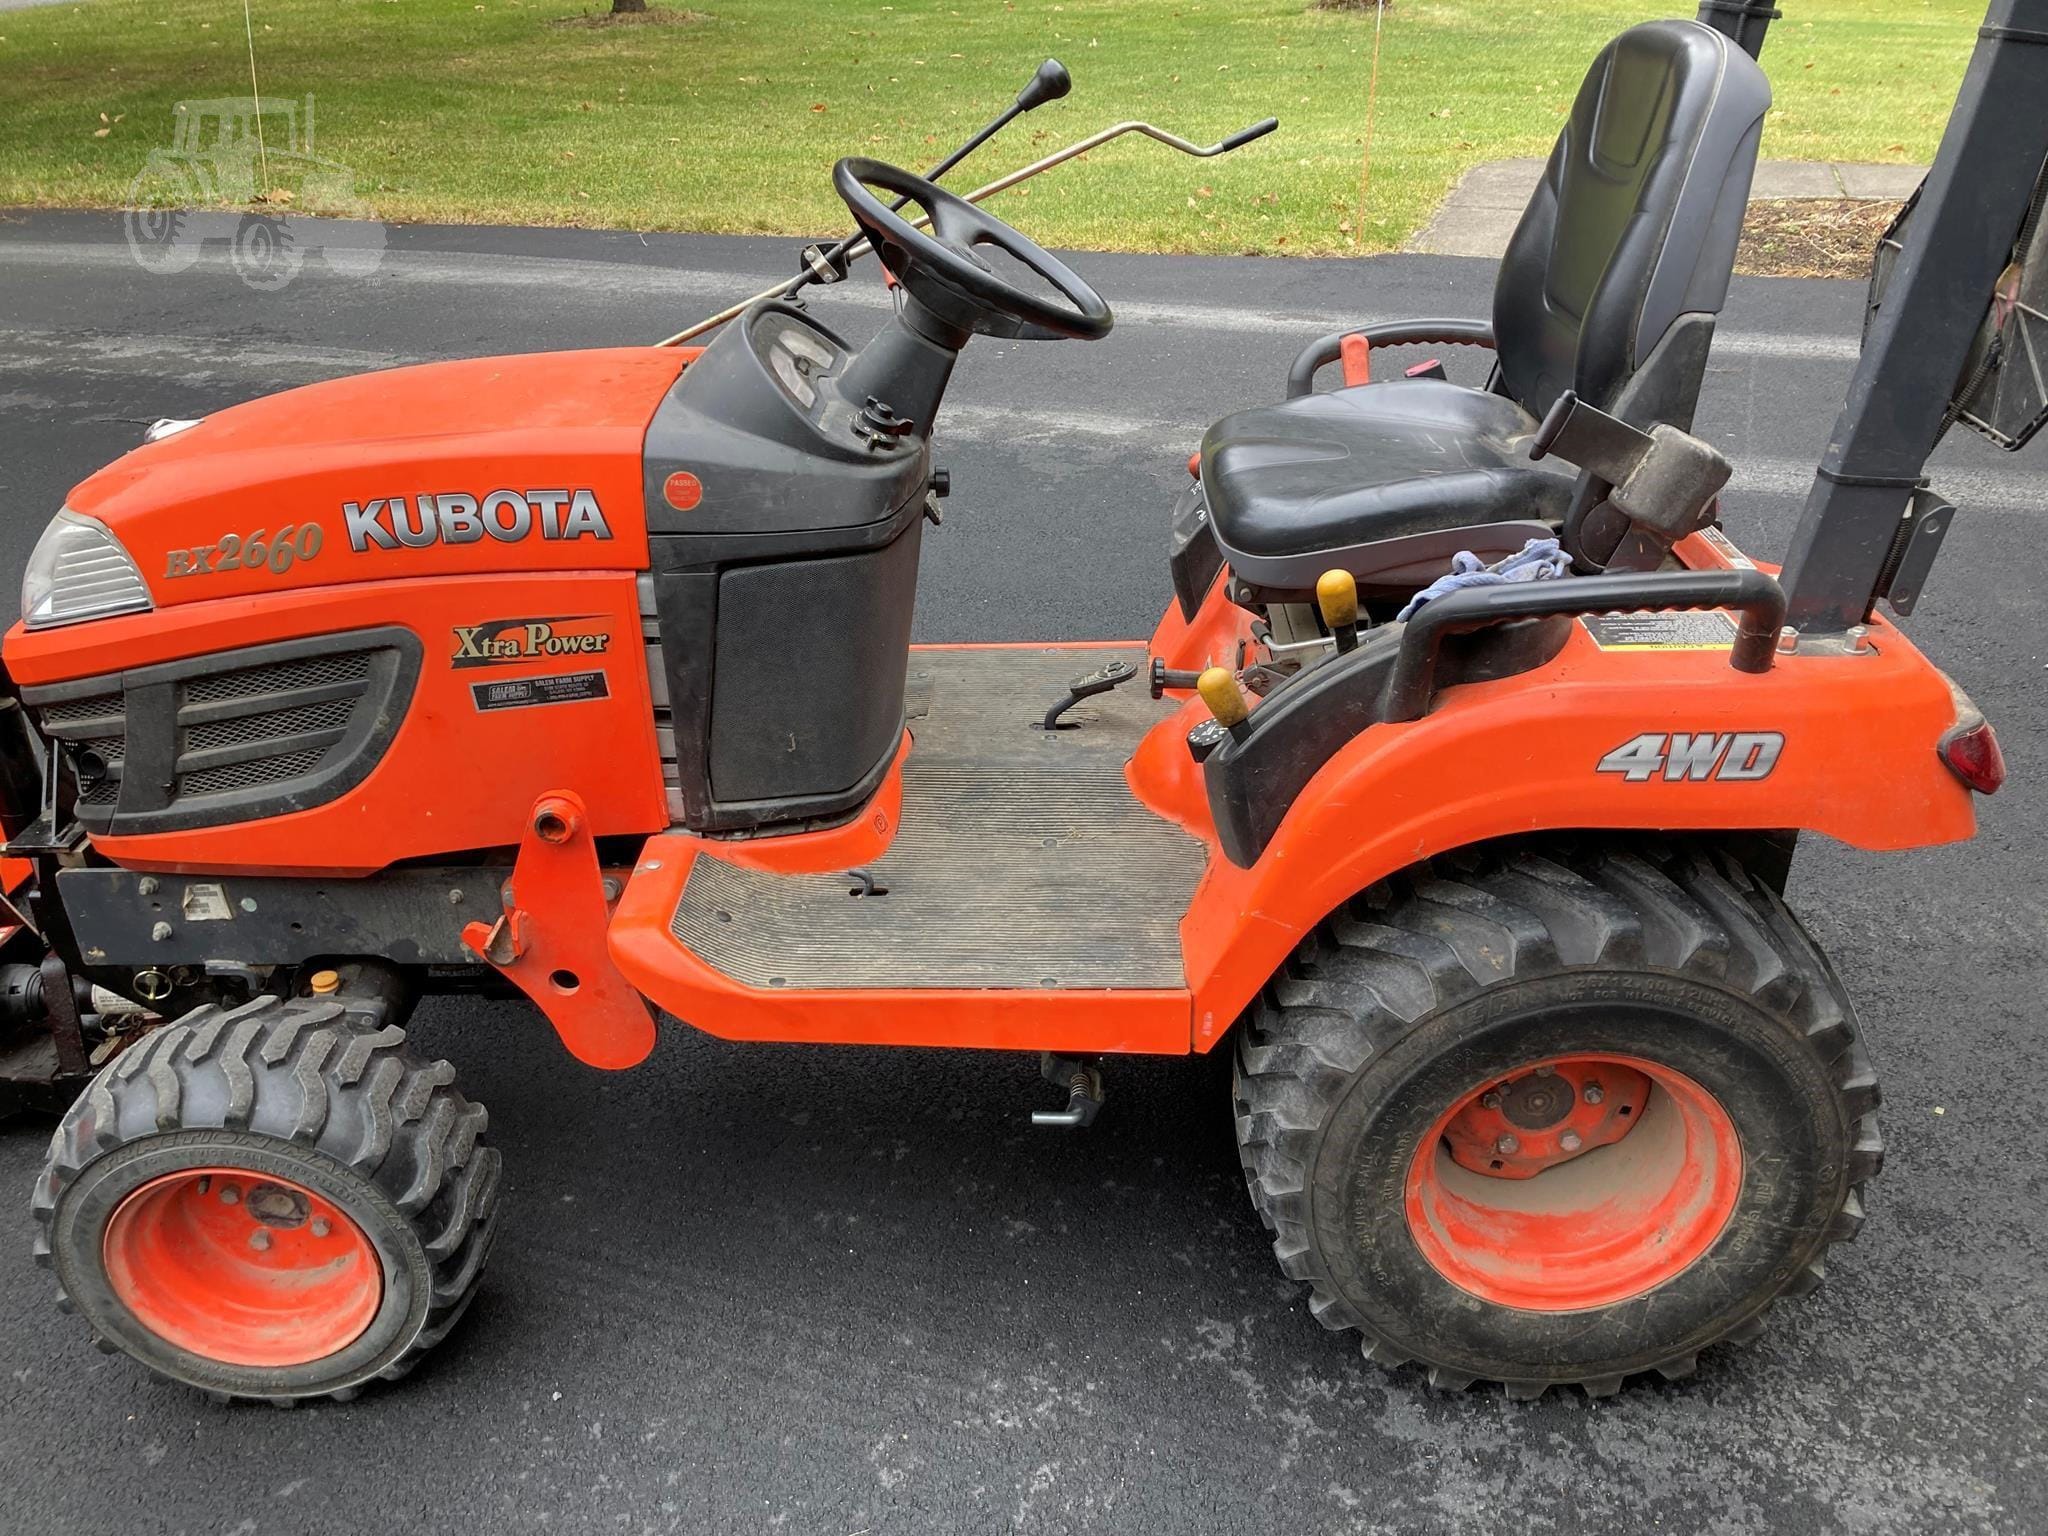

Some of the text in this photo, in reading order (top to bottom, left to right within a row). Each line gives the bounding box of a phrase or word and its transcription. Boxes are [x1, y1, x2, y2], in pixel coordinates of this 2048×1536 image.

[342, 490, 614, 552] KUBOTA
[164, 522, 323, 578] BX2660
[452, 623, 609, 659] Xtra Power
[491, 685, 517, 695] SALEM
[556, 677, 572, 686] FARM
[573, 674, 595, 684] SUPPLY
[1594, 731, 1786, 782] 4WD
[101, 1131, 272, 1173] TRACTION
[280, 1142, 410, 1232] MASTER
[1382, 1131, 1413, 1201] RIM GUARD
[1755, 1182, 1776, 1204] RIM
